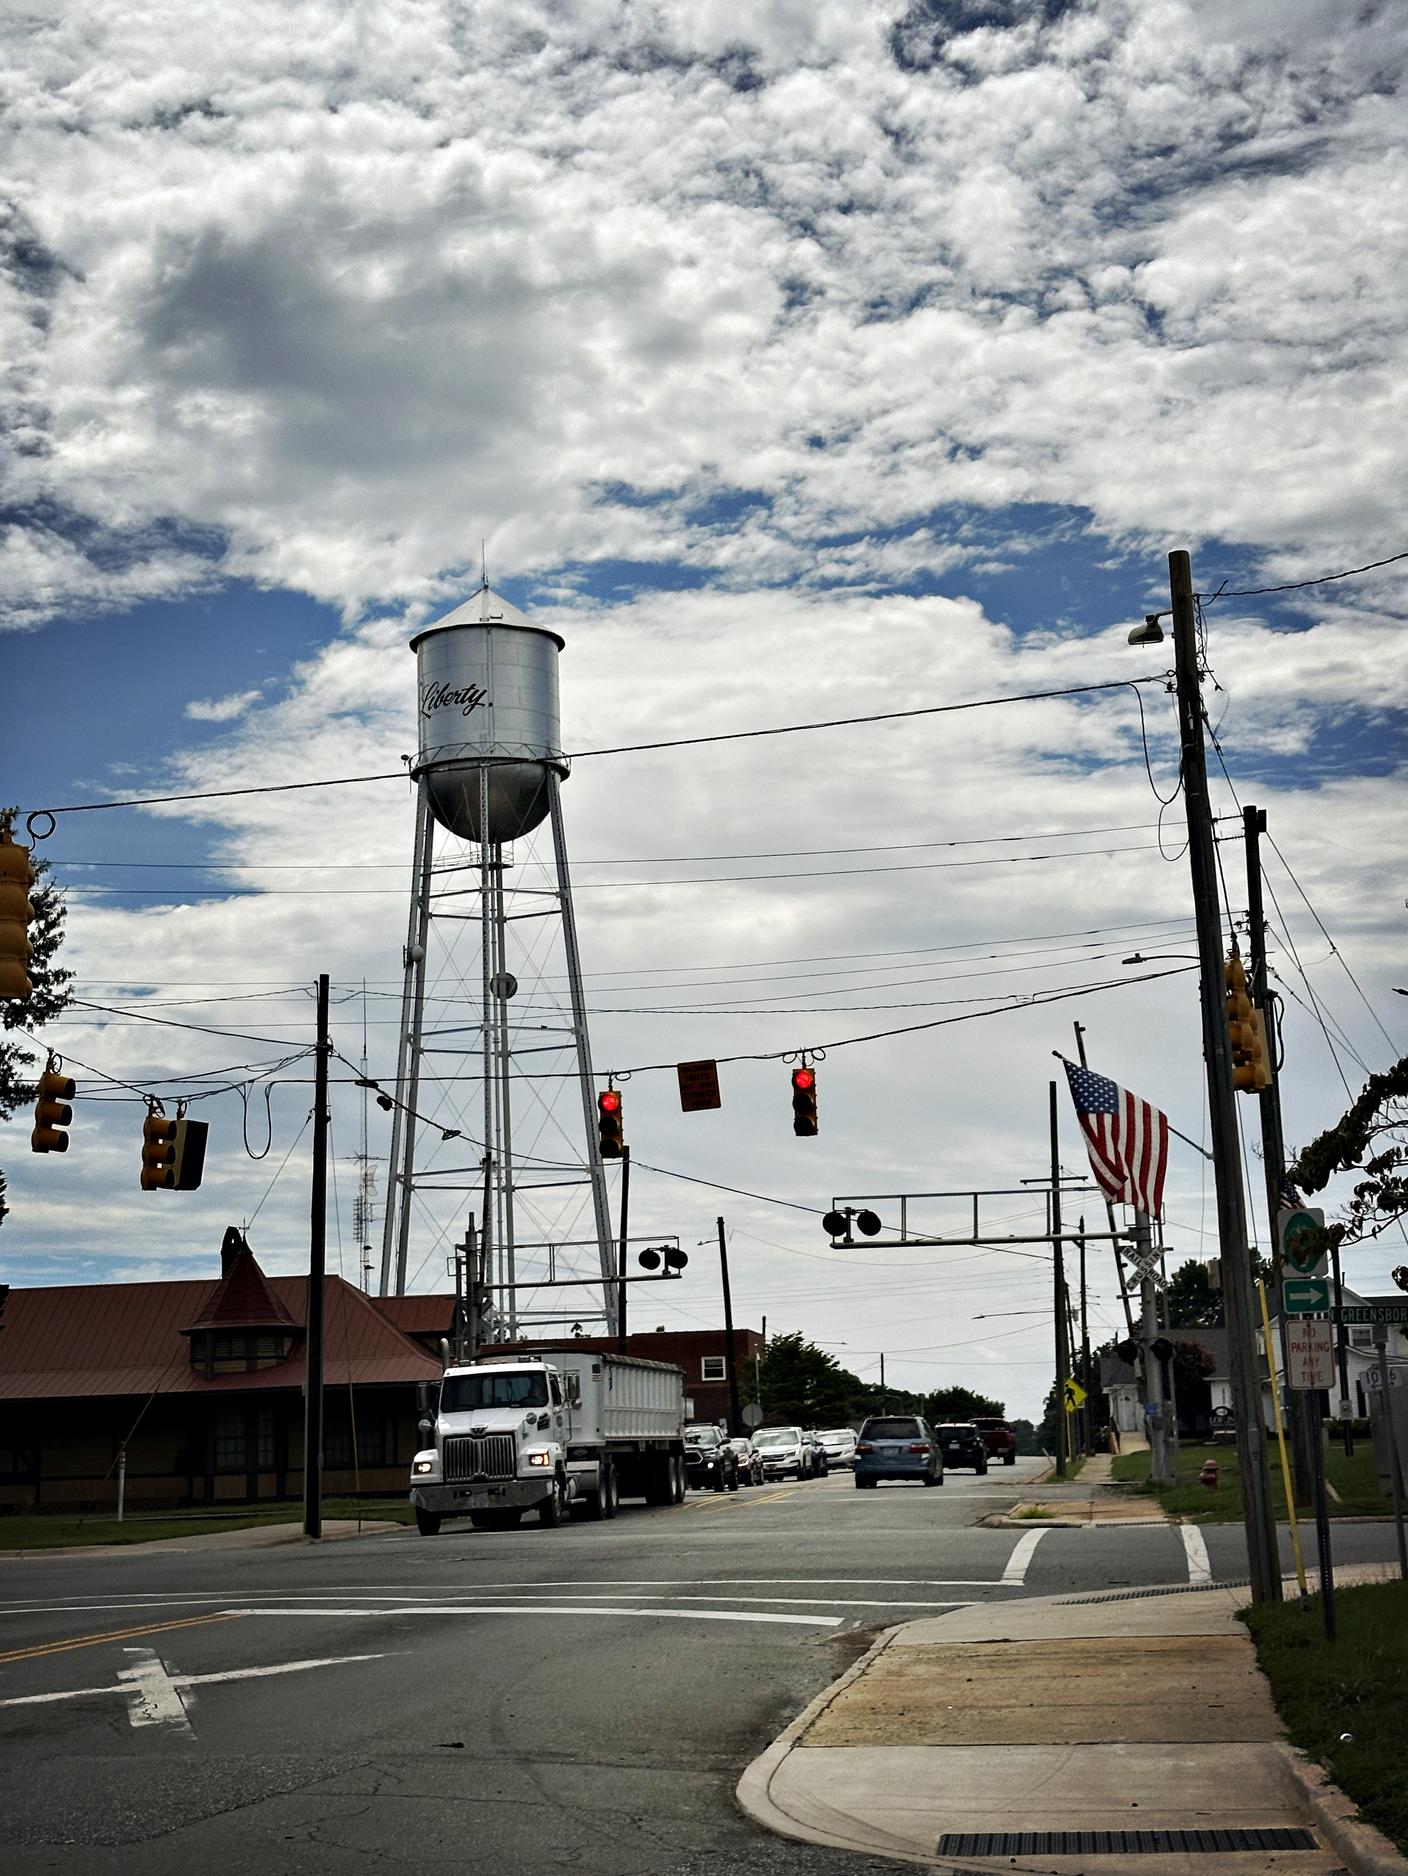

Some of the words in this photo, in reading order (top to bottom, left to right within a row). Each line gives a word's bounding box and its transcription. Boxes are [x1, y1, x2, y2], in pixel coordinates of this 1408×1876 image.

[1123, 1247, 1168, 1288] RAILROAD
[1302, 1327, 1316, 1338] NO
[1291, 1341, 1330, 1353] PARKING
[1302, 1356, 1320, 1367] ANY
